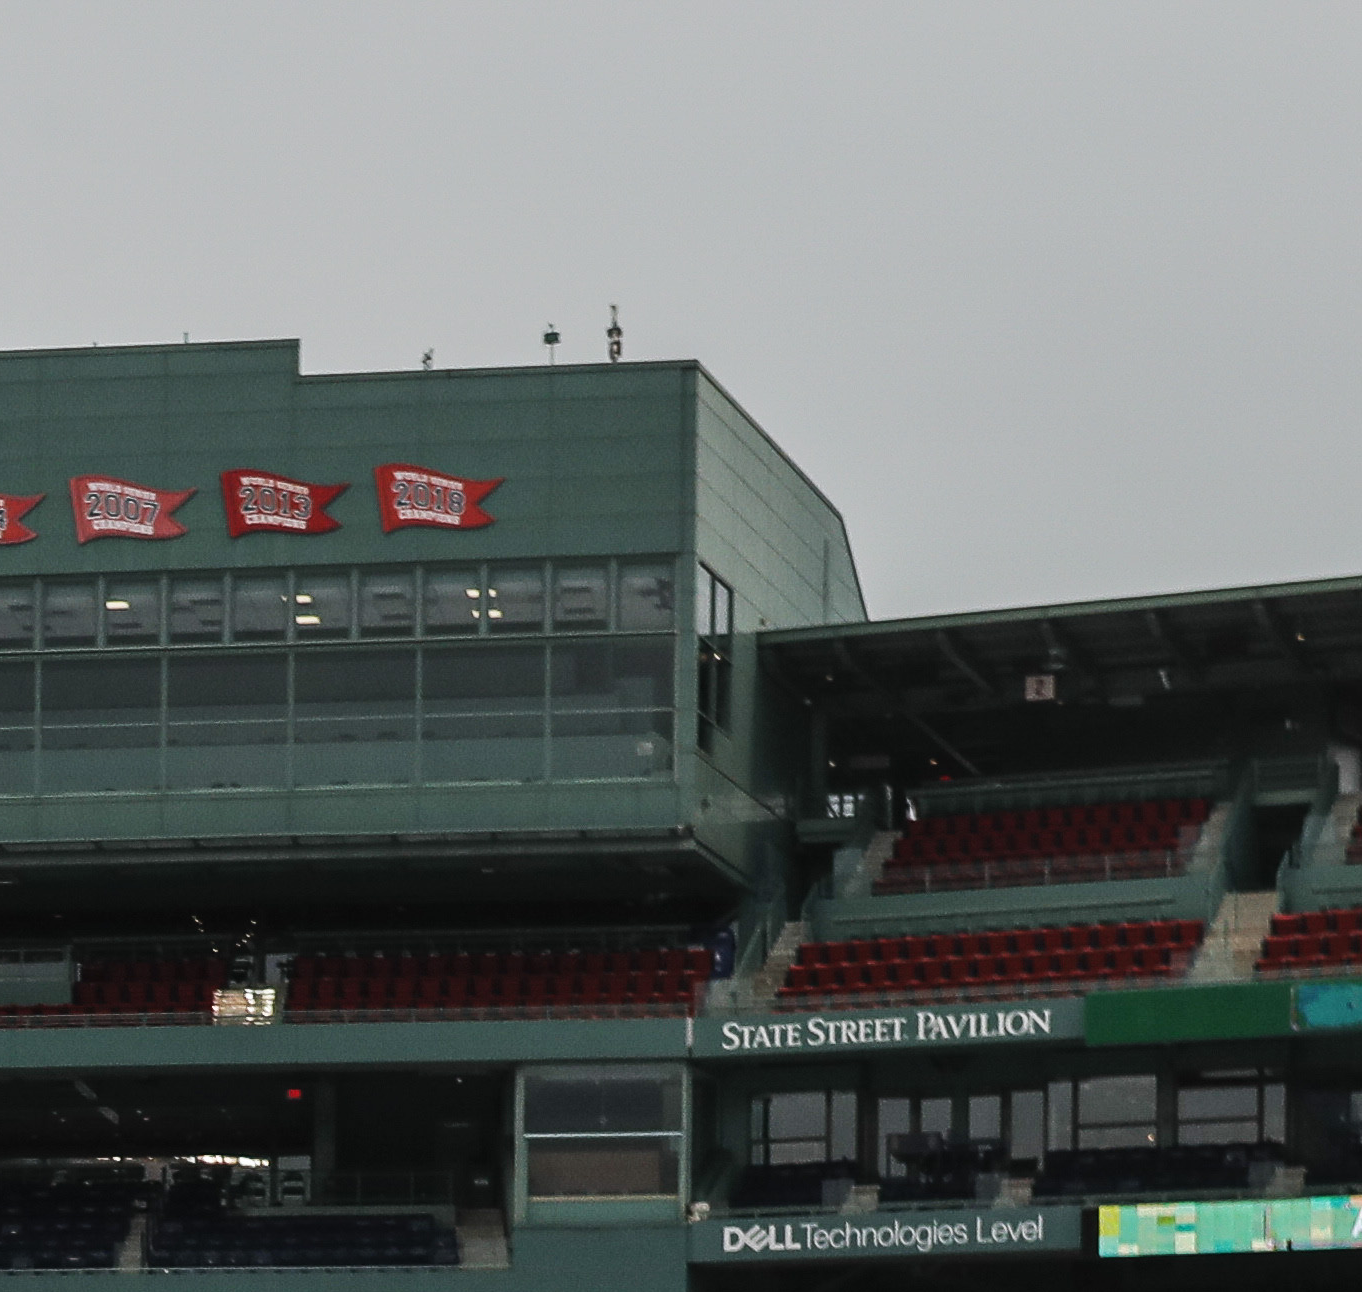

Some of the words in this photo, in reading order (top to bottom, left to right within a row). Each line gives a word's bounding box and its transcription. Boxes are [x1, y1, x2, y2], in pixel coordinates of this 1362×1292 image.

[85, 492, 161, 526] 2007
[239, 485, 312, 520] 2013
[391, 481, 467, 516] 2018
[721, 1021, 802, 1052] STATE
[807, 1016, 907, 1046] STREET
[916, 1009, 1052, 1041] PAVILION
[723, 1223, 801, 1253] DELL
[801, 1218, 968, 1252] Technologies
[976, 1213, 1044, 1245] Level
